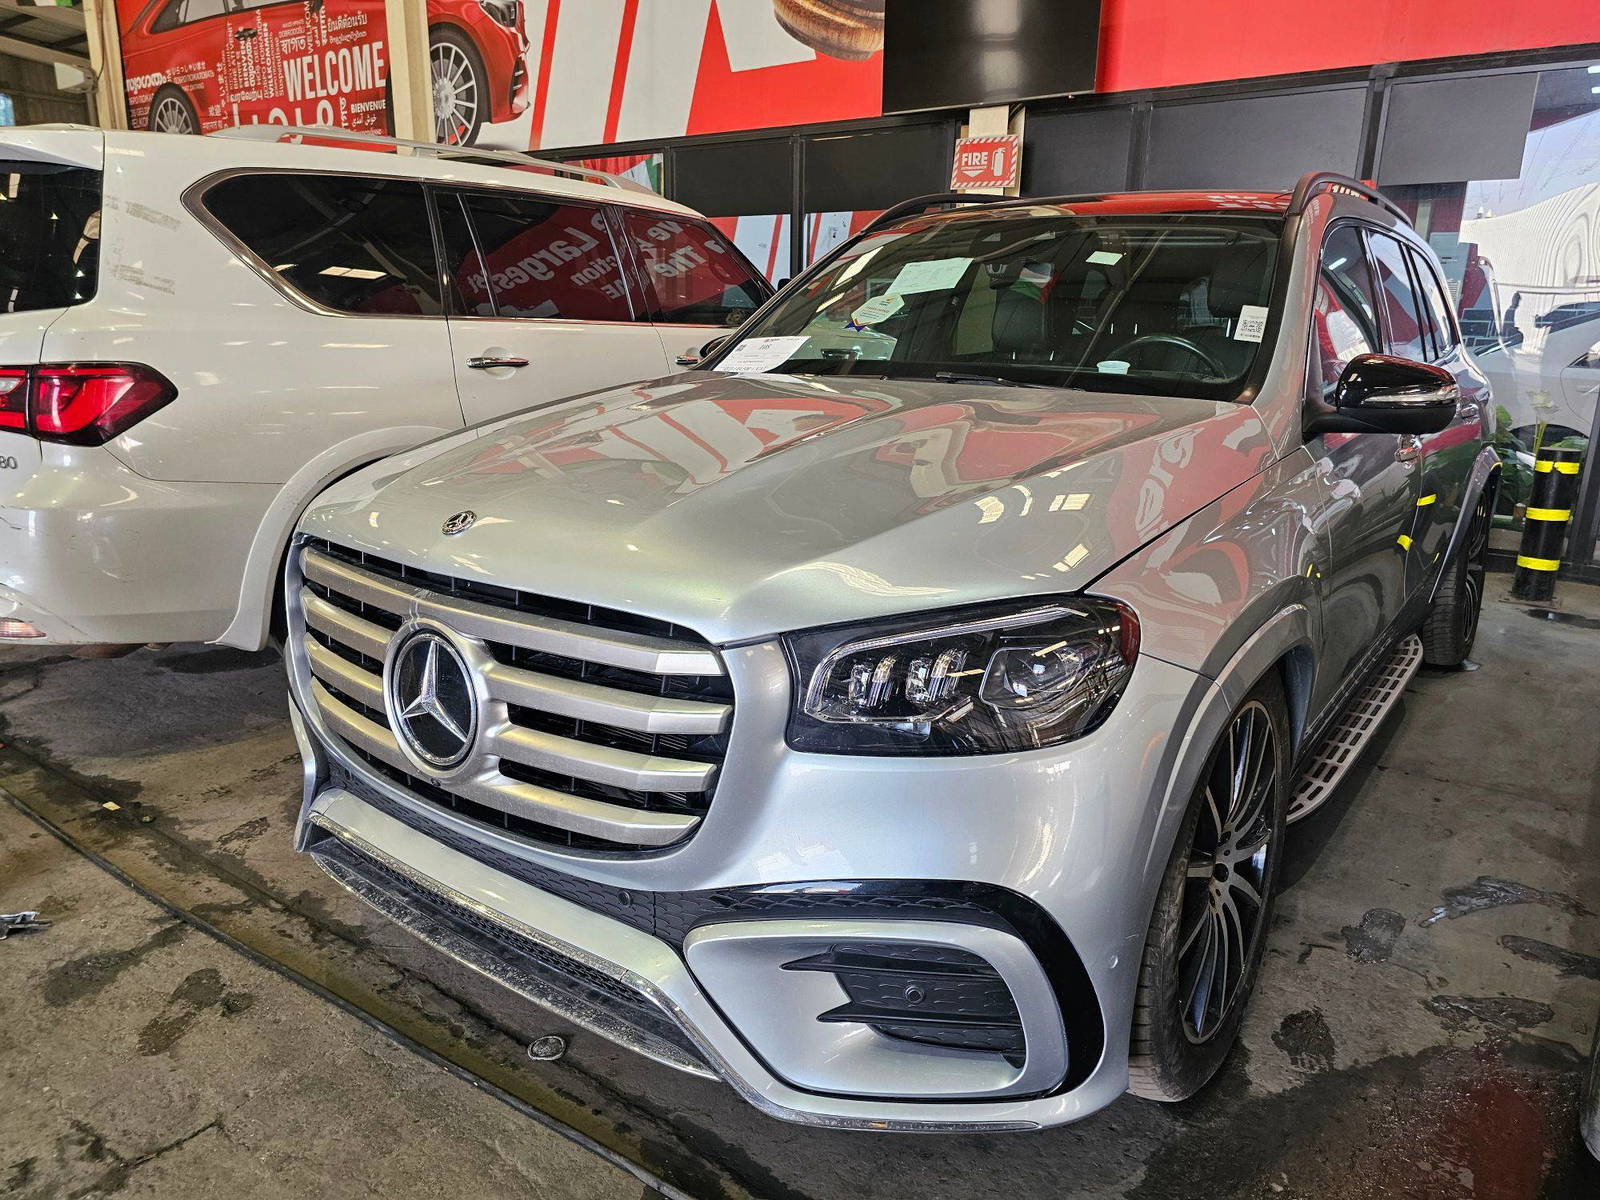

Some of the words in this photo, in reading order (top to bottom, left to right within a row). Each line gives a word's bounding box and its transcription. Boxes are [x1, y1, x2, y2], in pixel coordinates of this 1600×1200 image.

[283, 41, 387, 102] WELCOME
[350, 99, 387, 114] BIENVENUE
[961, 151, 989, 166] FIRE
[0, 455, 18, 470] 80
